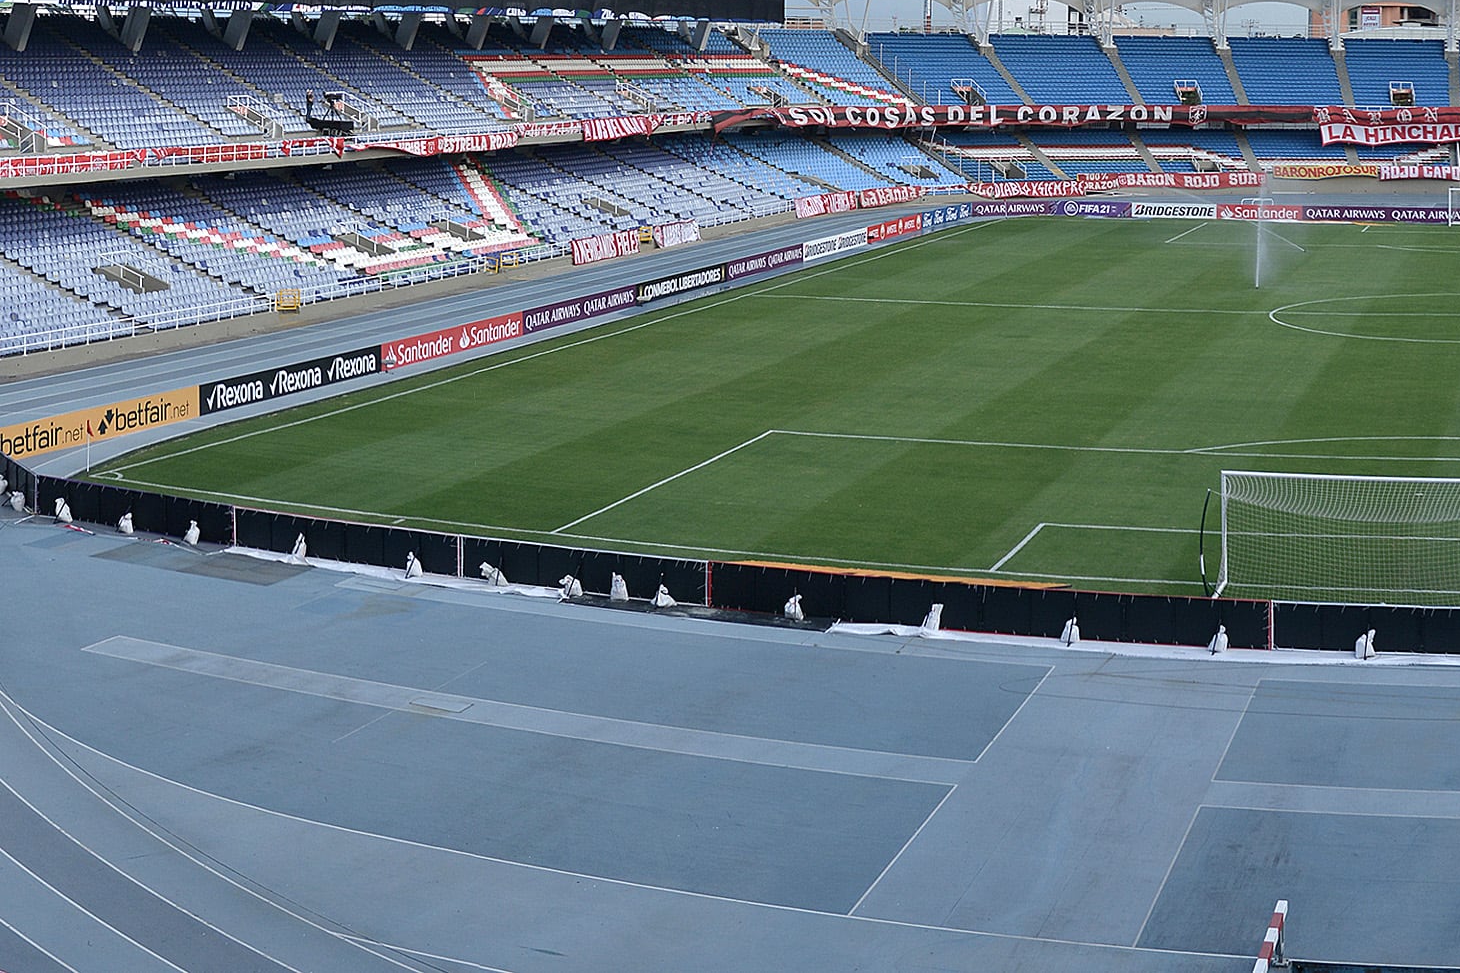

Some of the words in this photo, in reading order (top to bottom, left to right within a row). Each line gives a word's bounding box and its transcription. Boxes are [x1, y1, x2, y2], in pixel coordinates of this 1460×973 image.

[845, 106, 936, 128] COSAS
[947, 105, 1004, 125] DEL
[1017, 105, 1173, 125] CORAZON
[1314, 107, 1440, 125] BARON
[1328, 125, 1356, 140] LA
[1126, 174, 1176, 187] BARON
[1184, 174, 1220, 188] ROJO
[1228, 174, 1257, 186] SUR
[1381, 165, 1418, 180] ROJO
[976, 203, 1005, 214] QATAR
[1007, 203, 1045, 214] AIRWAYS
[1135, 204, 1214, 217] BRIDGESTONE
[1235, 206, 1299, 219] Santander
[1306, 209, 1340, 219] QATAR
[1343, 209, 1386, 219] AIRWAYS
[1392, 210, 1426, 220] QATAR
[804, 239, 838, 259] BRIDGESTONE
[837, 231, 867, 251] BRIDGESTONE
[728, 260, 747, 278] QATAR
[746, 255, 767, 272] AIRWAYS
[767, 250, 784, 268] QATAR
[783, 247, 803, 264] AIRWAYS
[643, 279, 680, 299] CONMEBOL
[678, 267, 721, 290] LIBERTADORES
[584, 296, 608, 316] QATAR
[606, 289, 635, 311] AIRWAYS
[526, 310, 551, 331] QATAR
[550, 301, 581, 325] AIRWAYS
[469, 318, 522, 346] Santander
[397, 335, 454, 365] Santander
[335, 353, 377, 381] Rexona
[278, 366, 322, 395] Rexona
[217, 380, 264, 410] Rexona
[115, 397, 190, 432] betfair.net
